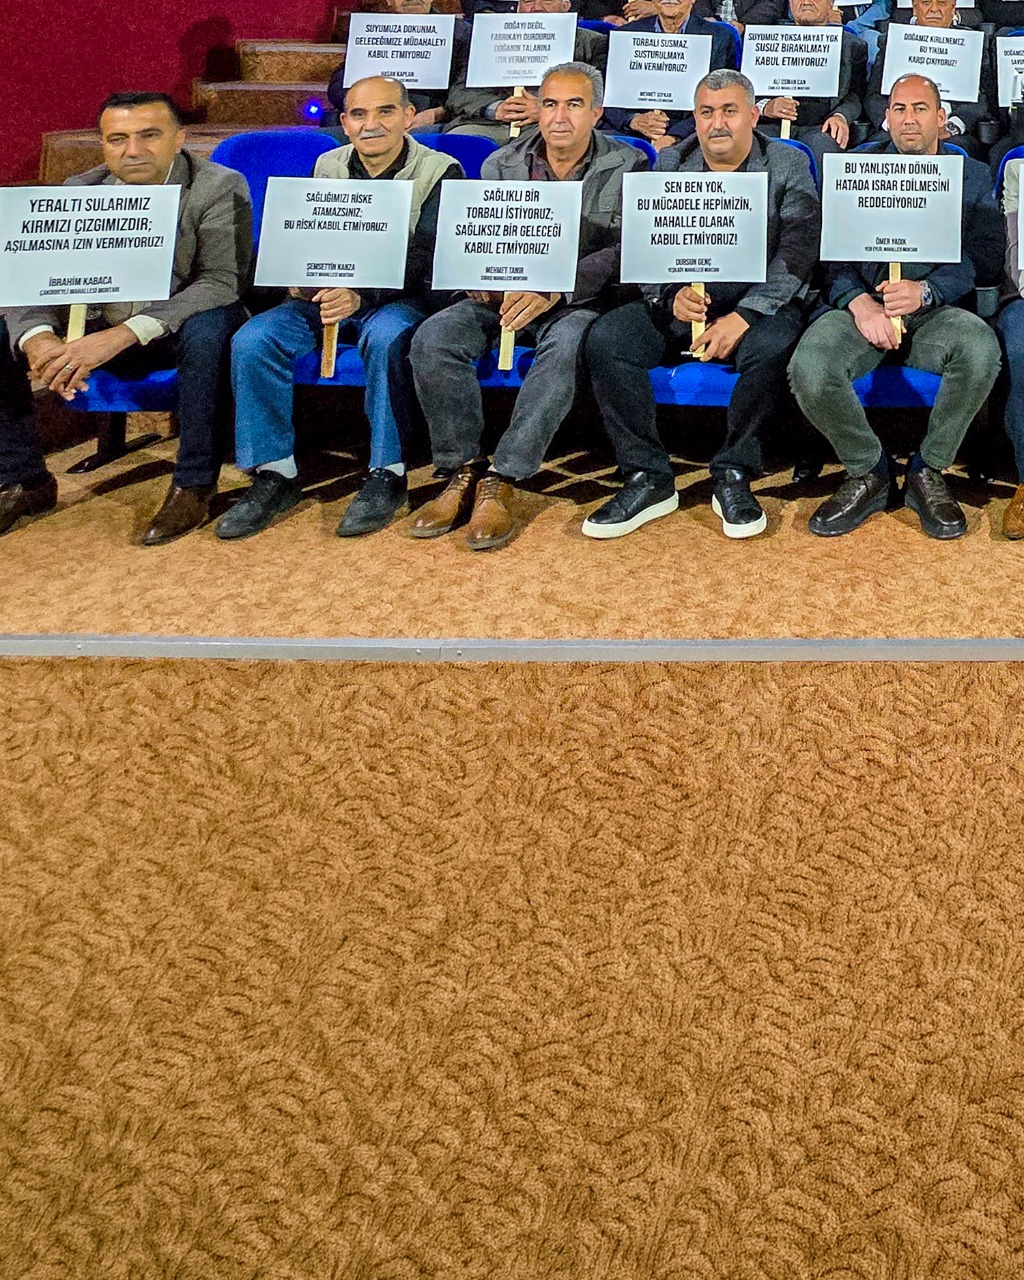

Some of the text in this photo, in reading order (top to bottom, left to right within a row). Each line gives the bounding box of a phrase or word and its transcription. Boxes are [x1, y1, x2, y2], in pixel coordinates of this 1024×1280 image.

[748, 32, 779, 41] SUYUMUZ
[780, 33, 801, 41] YOKSA
[825, 34, 838, 42] YOK
[755, 42, 830, 53] SUSUZ BIRAKILMAYI
[755, 56, 779, 66] KABUL
[844, 161, 941, 176] BU YANLIŞTAN DÖNÜN,
[664, 181, 726, 194] SEN BEN YOK,
[835, 178, 949, 192] HATADA ISRAR EDİLMESİNİ
[305, 191, 373, 204] SAĞLIĞIMIZI RİSKE
[483, 187, 540, 202] SAĞLIKLI BİR
[858, 194, 926, 208] REDDEDİYORUZ!
[30, 197, 150, 212] YERALTI SULARIMIZ
[637, 196, 752, 211] BU MÜCADELE HEPİMİZİN,
[466, 205, 553, 220] TORBALI İSTİYORUZ;
[21, 219, 71, 233] KIRMIZI
[283, 218, 387, 231] BU RİSKİ KABUL ETMİYORUZ!
[654, 215, 734, 228] MAHALLE OLARAK
[455, 222, 561, 237] SAĞLIKSIZ BİR GELECEĞİ
[650, 231, 737, 245] KABUL ETMİYORUZ!
[4, 239, 69, 253] AŞILMASINA
[464, 240, 549, 254] KABUL ETMİYORUZ!
[82, 276, 112, 285] KABACA
